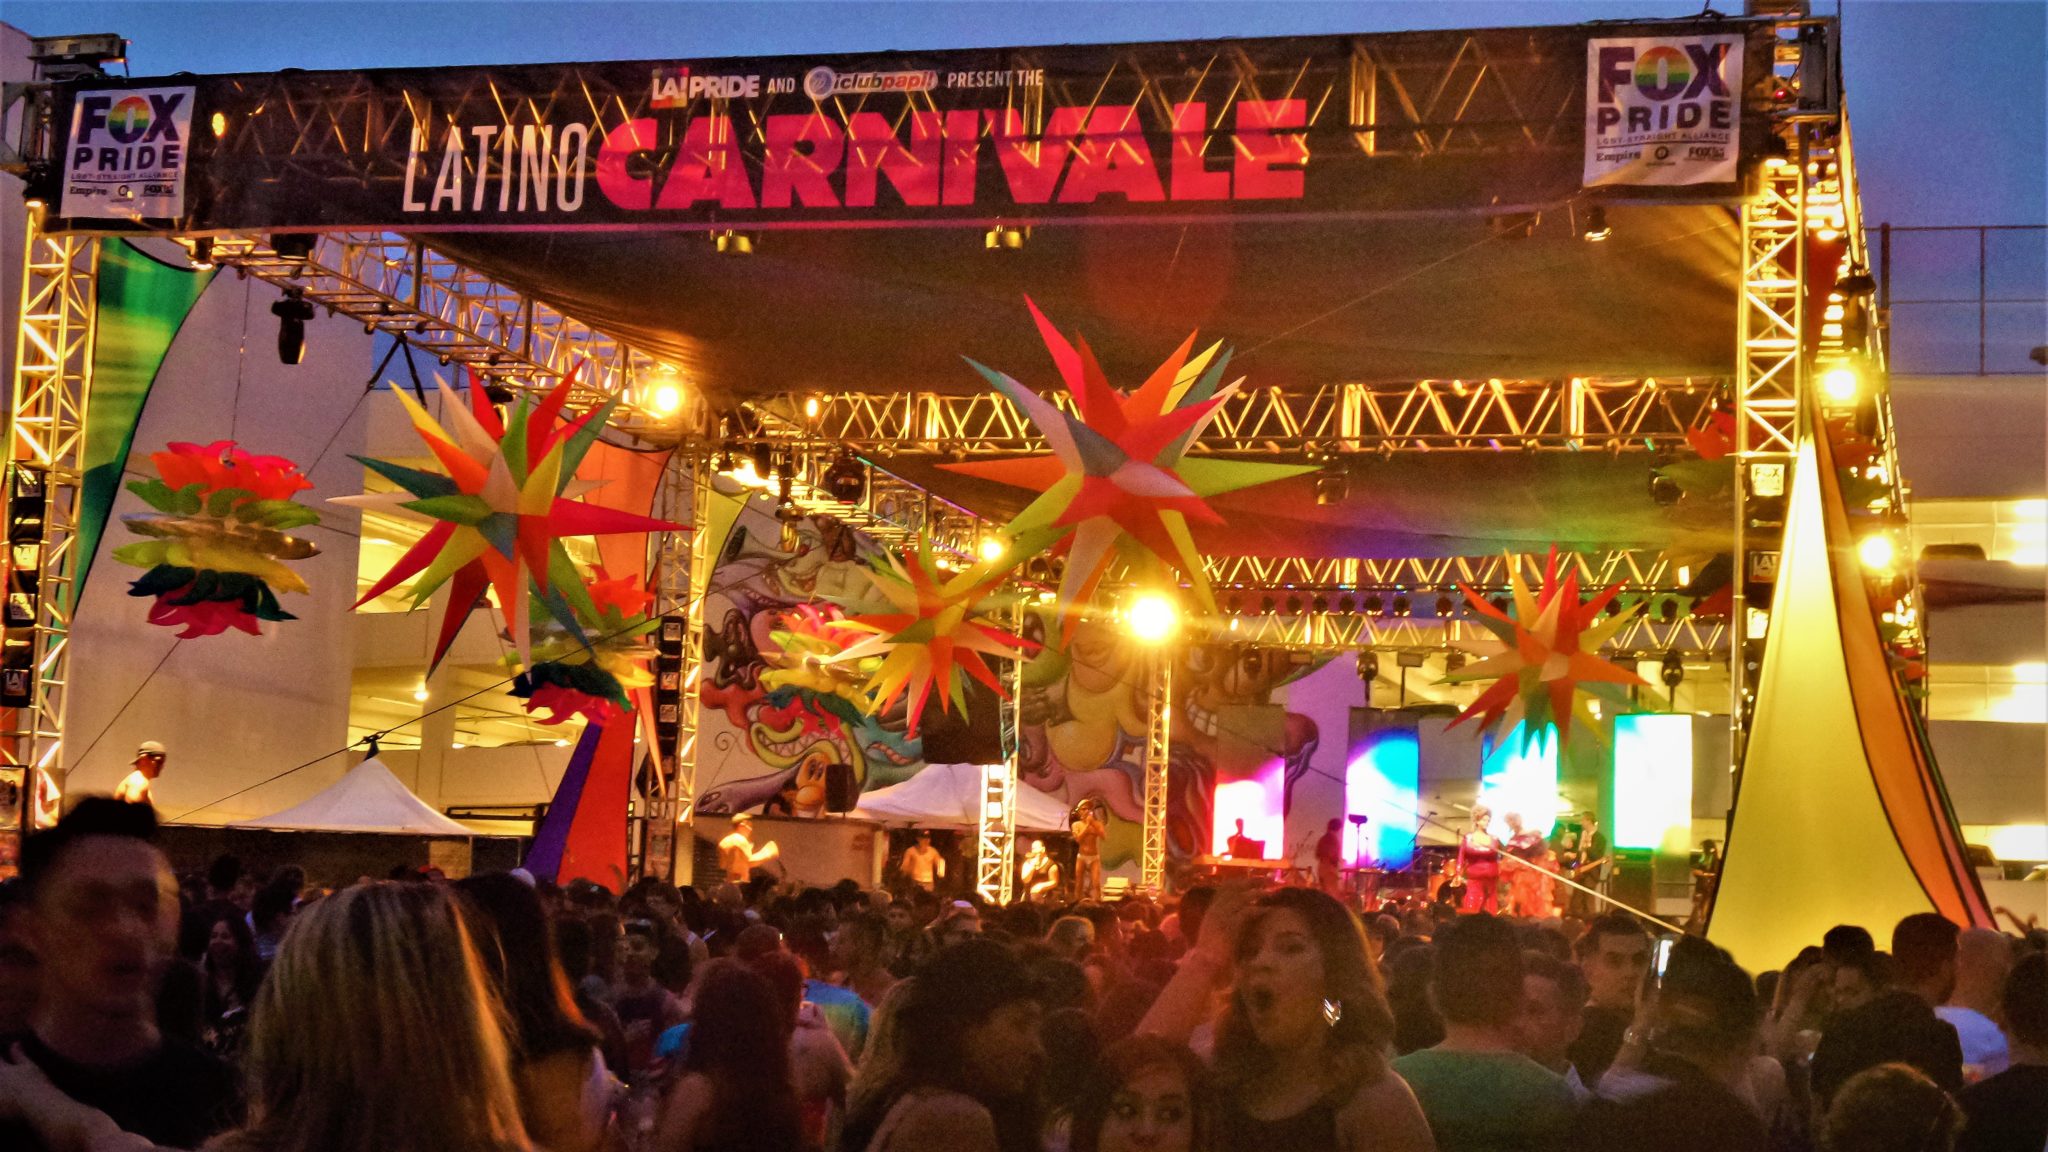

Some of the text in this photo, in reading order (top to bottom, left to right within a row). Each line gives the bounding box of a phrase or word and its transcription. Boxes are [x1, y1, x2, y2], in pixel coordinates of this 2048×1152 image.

[689, 75, 760, 99] PRIDE
[767, 77, 796, 94] AND
[947, 70, 1013, 88] PRESENT
[1018, 69, 1043, 86] THE
[1598, 43, 1732, 103] FOX
[77, 93, 185, 144] FOX
[1597, 100, 1731, 135] PRIDE
[73, 145, 180, 171] PRIDE
[402, 99, 1307, 212] LATINO CARNIVALE
[1596, 150, 1642, 163] Empire
[70, 186, 108, 197] Empire
